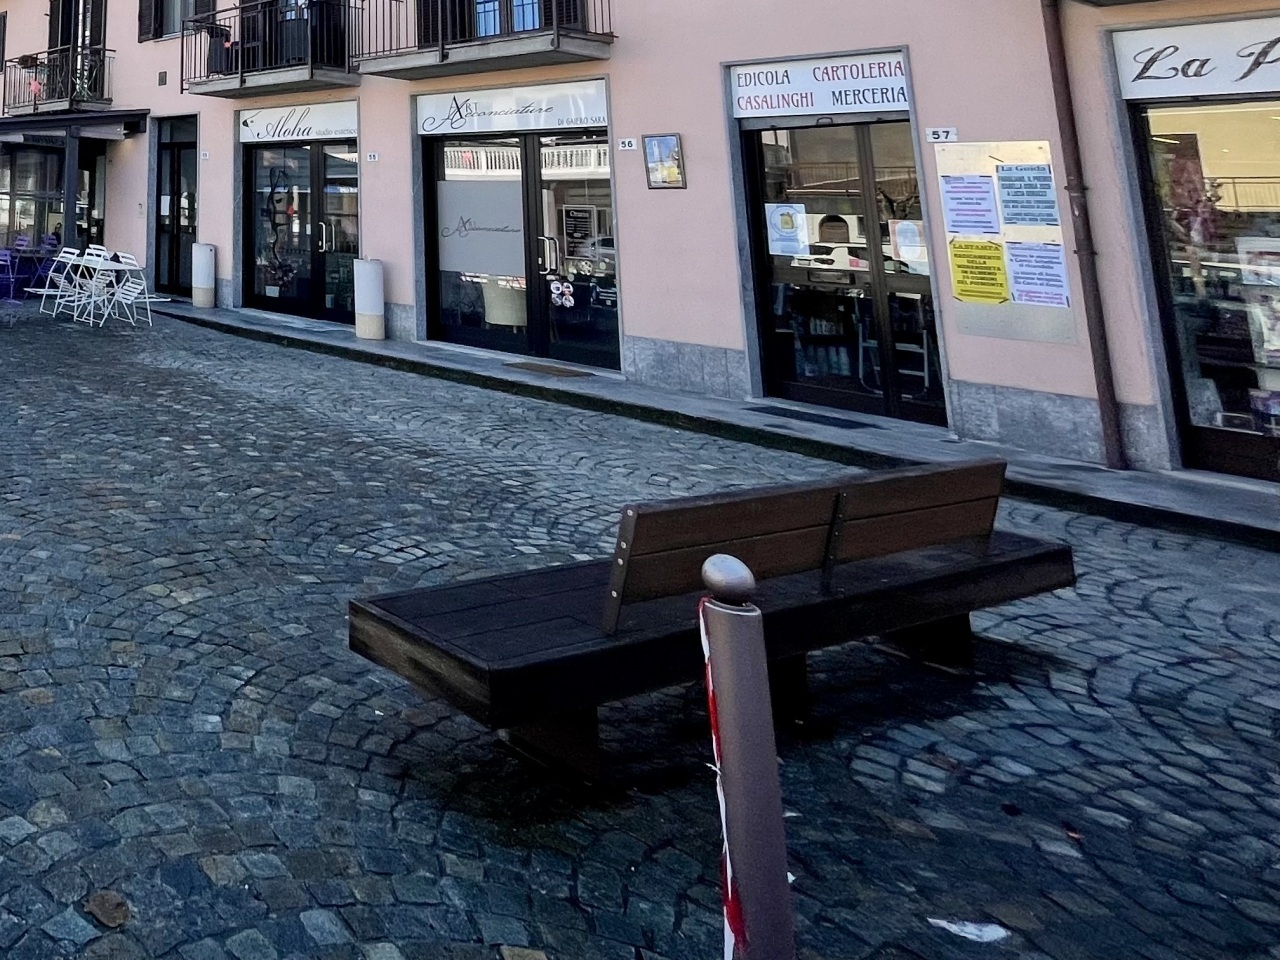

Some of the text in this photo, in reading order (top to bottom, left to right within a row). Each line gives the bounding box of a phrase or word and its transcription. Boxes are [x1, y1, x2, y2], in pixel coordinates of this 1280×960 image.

[737, 60, 905, 88] EDICOLA CARTOLERIA
[1131, 44, 1218, 82] La
[737, 86, 908, 111] CASALINGHI MERCERIA
[256, 107, 313, 139] Aloha
[932, 131, 951, 139] 57
[621, 140, 633, 148] 56
